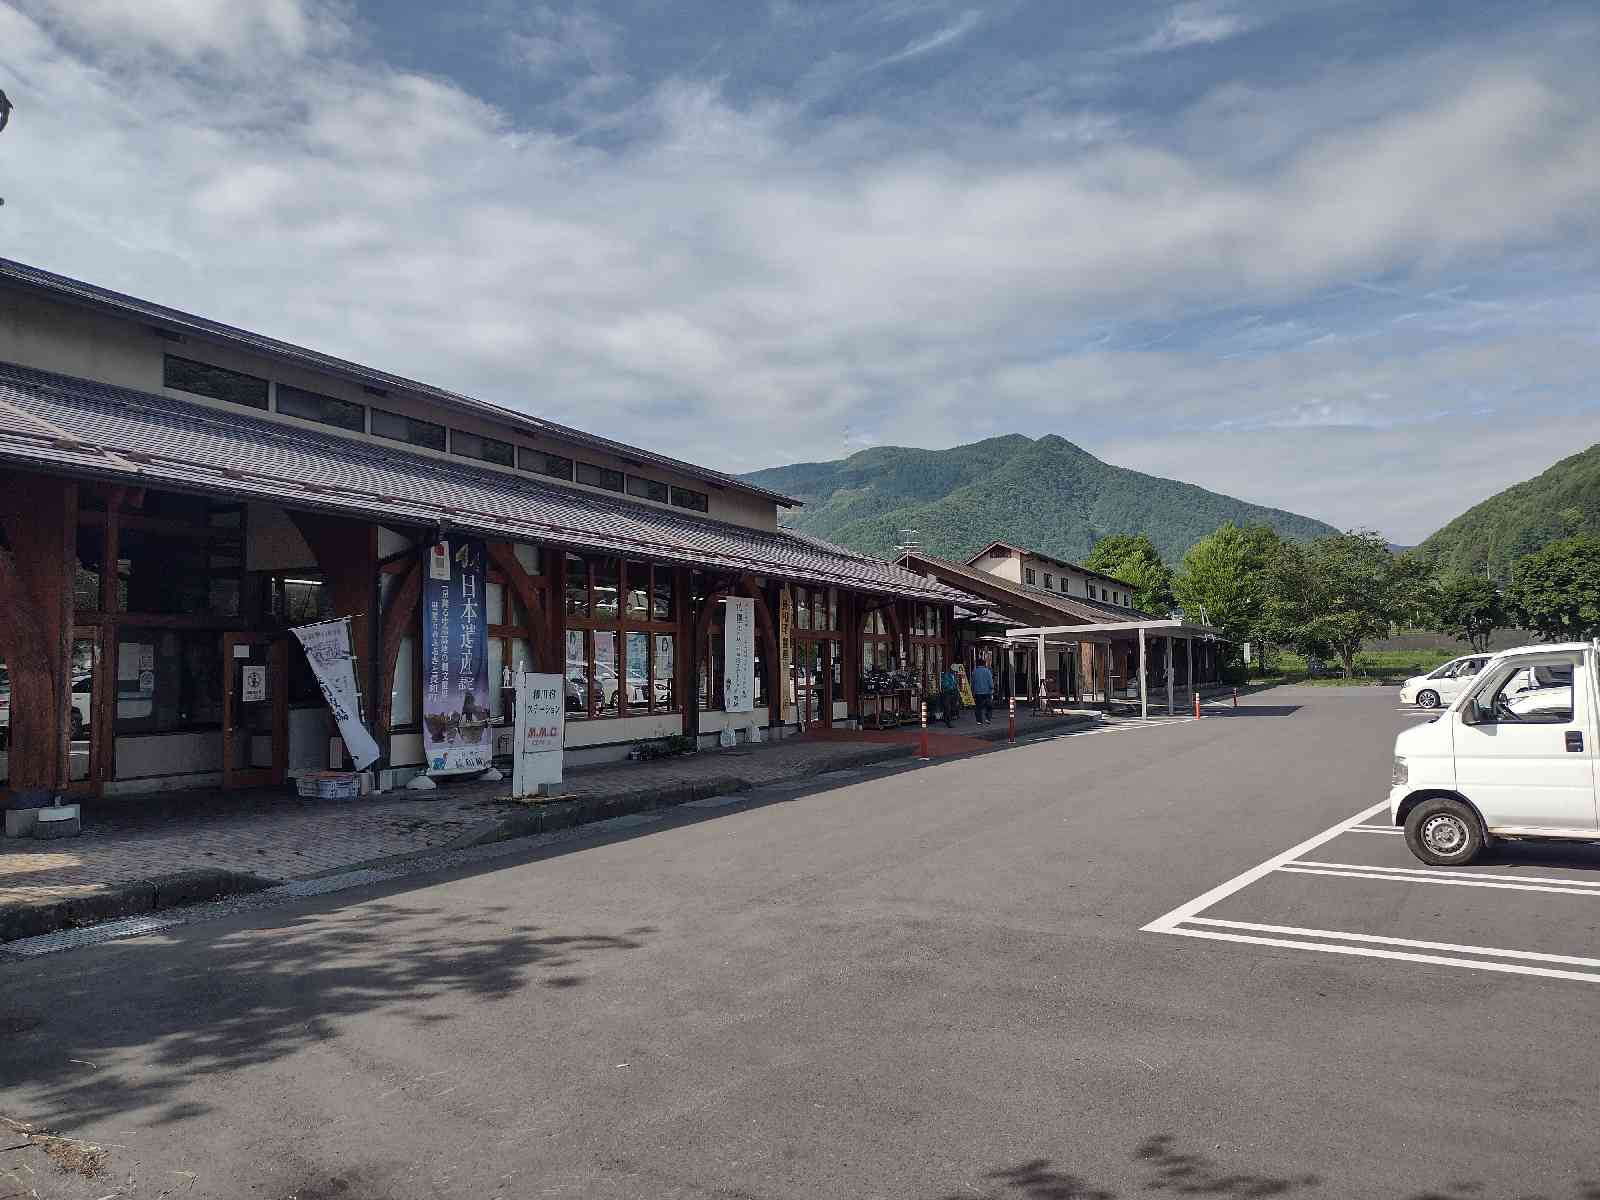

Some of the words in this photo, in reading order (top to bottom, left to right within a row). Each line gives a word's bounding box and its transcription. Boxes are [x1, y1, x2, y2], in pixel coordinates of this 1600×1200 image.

[527, 703, 561, 714] ステーション
